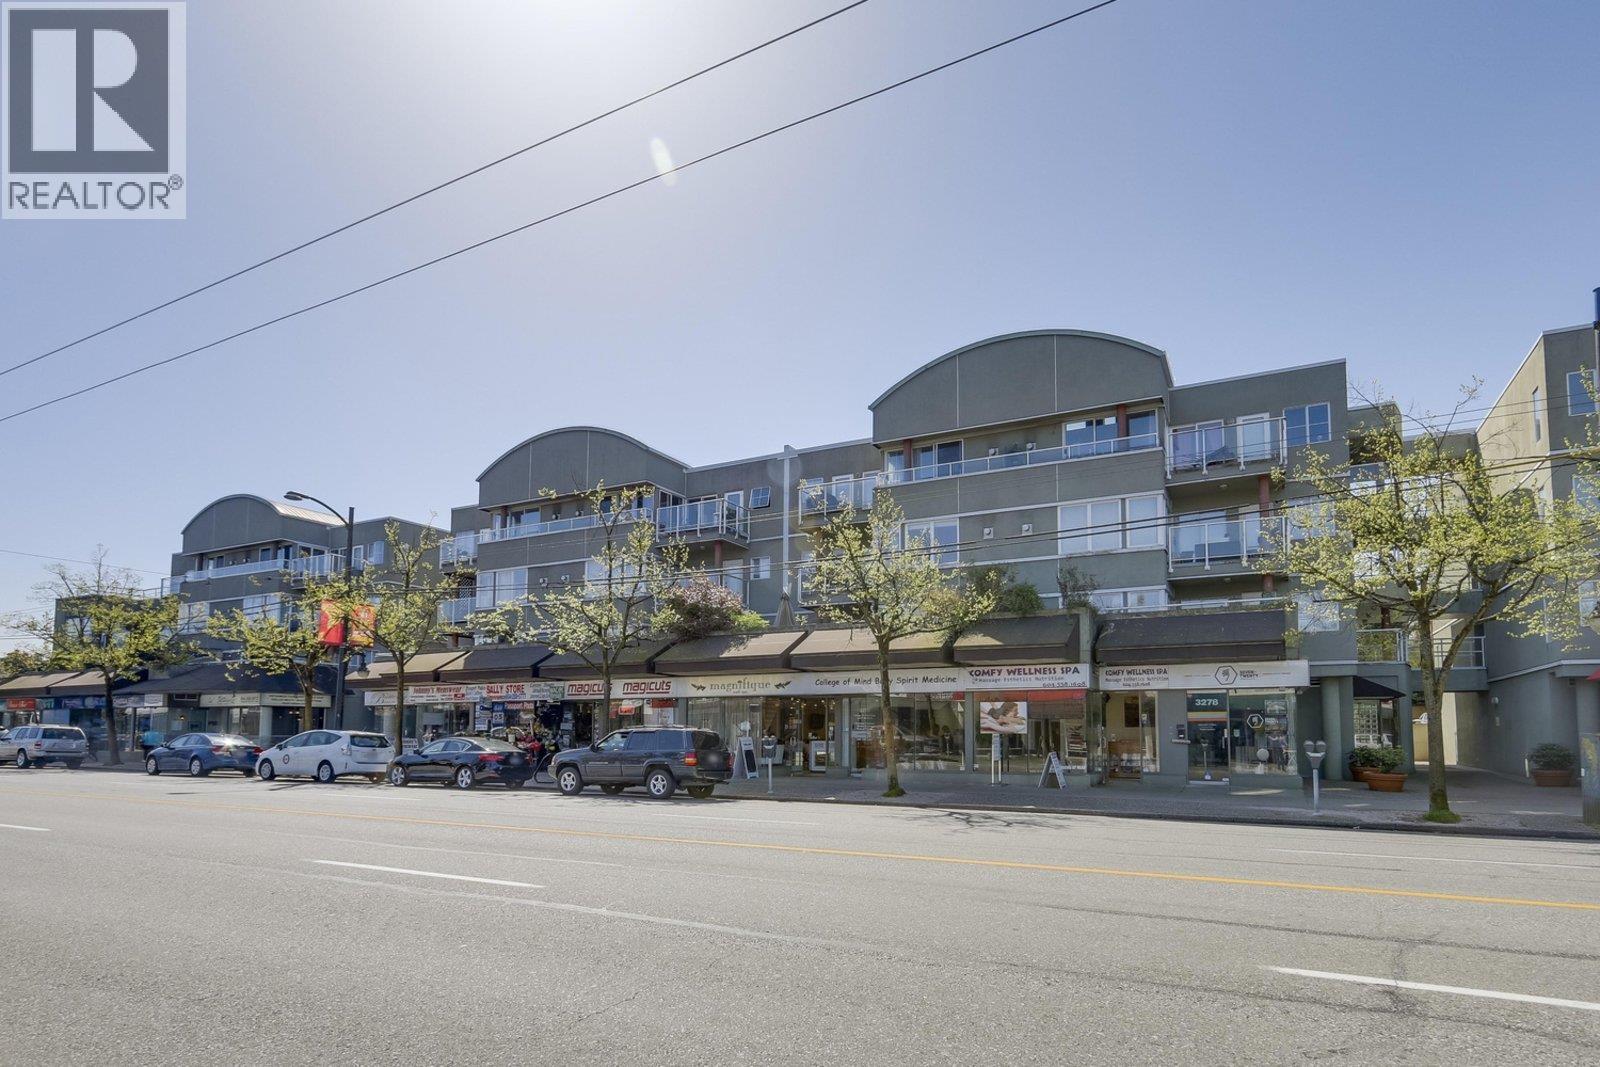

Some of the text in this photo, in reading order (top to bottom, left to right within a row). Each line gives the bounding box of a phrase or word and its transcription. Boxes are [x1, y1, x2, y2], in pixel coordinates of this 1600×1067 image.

[969, 666, 1080, 677] COMFY WELLNESS SPA
[1126, 668, 1155, 676] WELLNESS
[815, 675, 958, 687] College of Mind By Spirit Medicine
[486, 684, 503, 694] SALLY
[506, 683, 525, 694] STORE
[622, 680, 672, 694] magicuts
[1195, 698, 1219, 706] 3278
